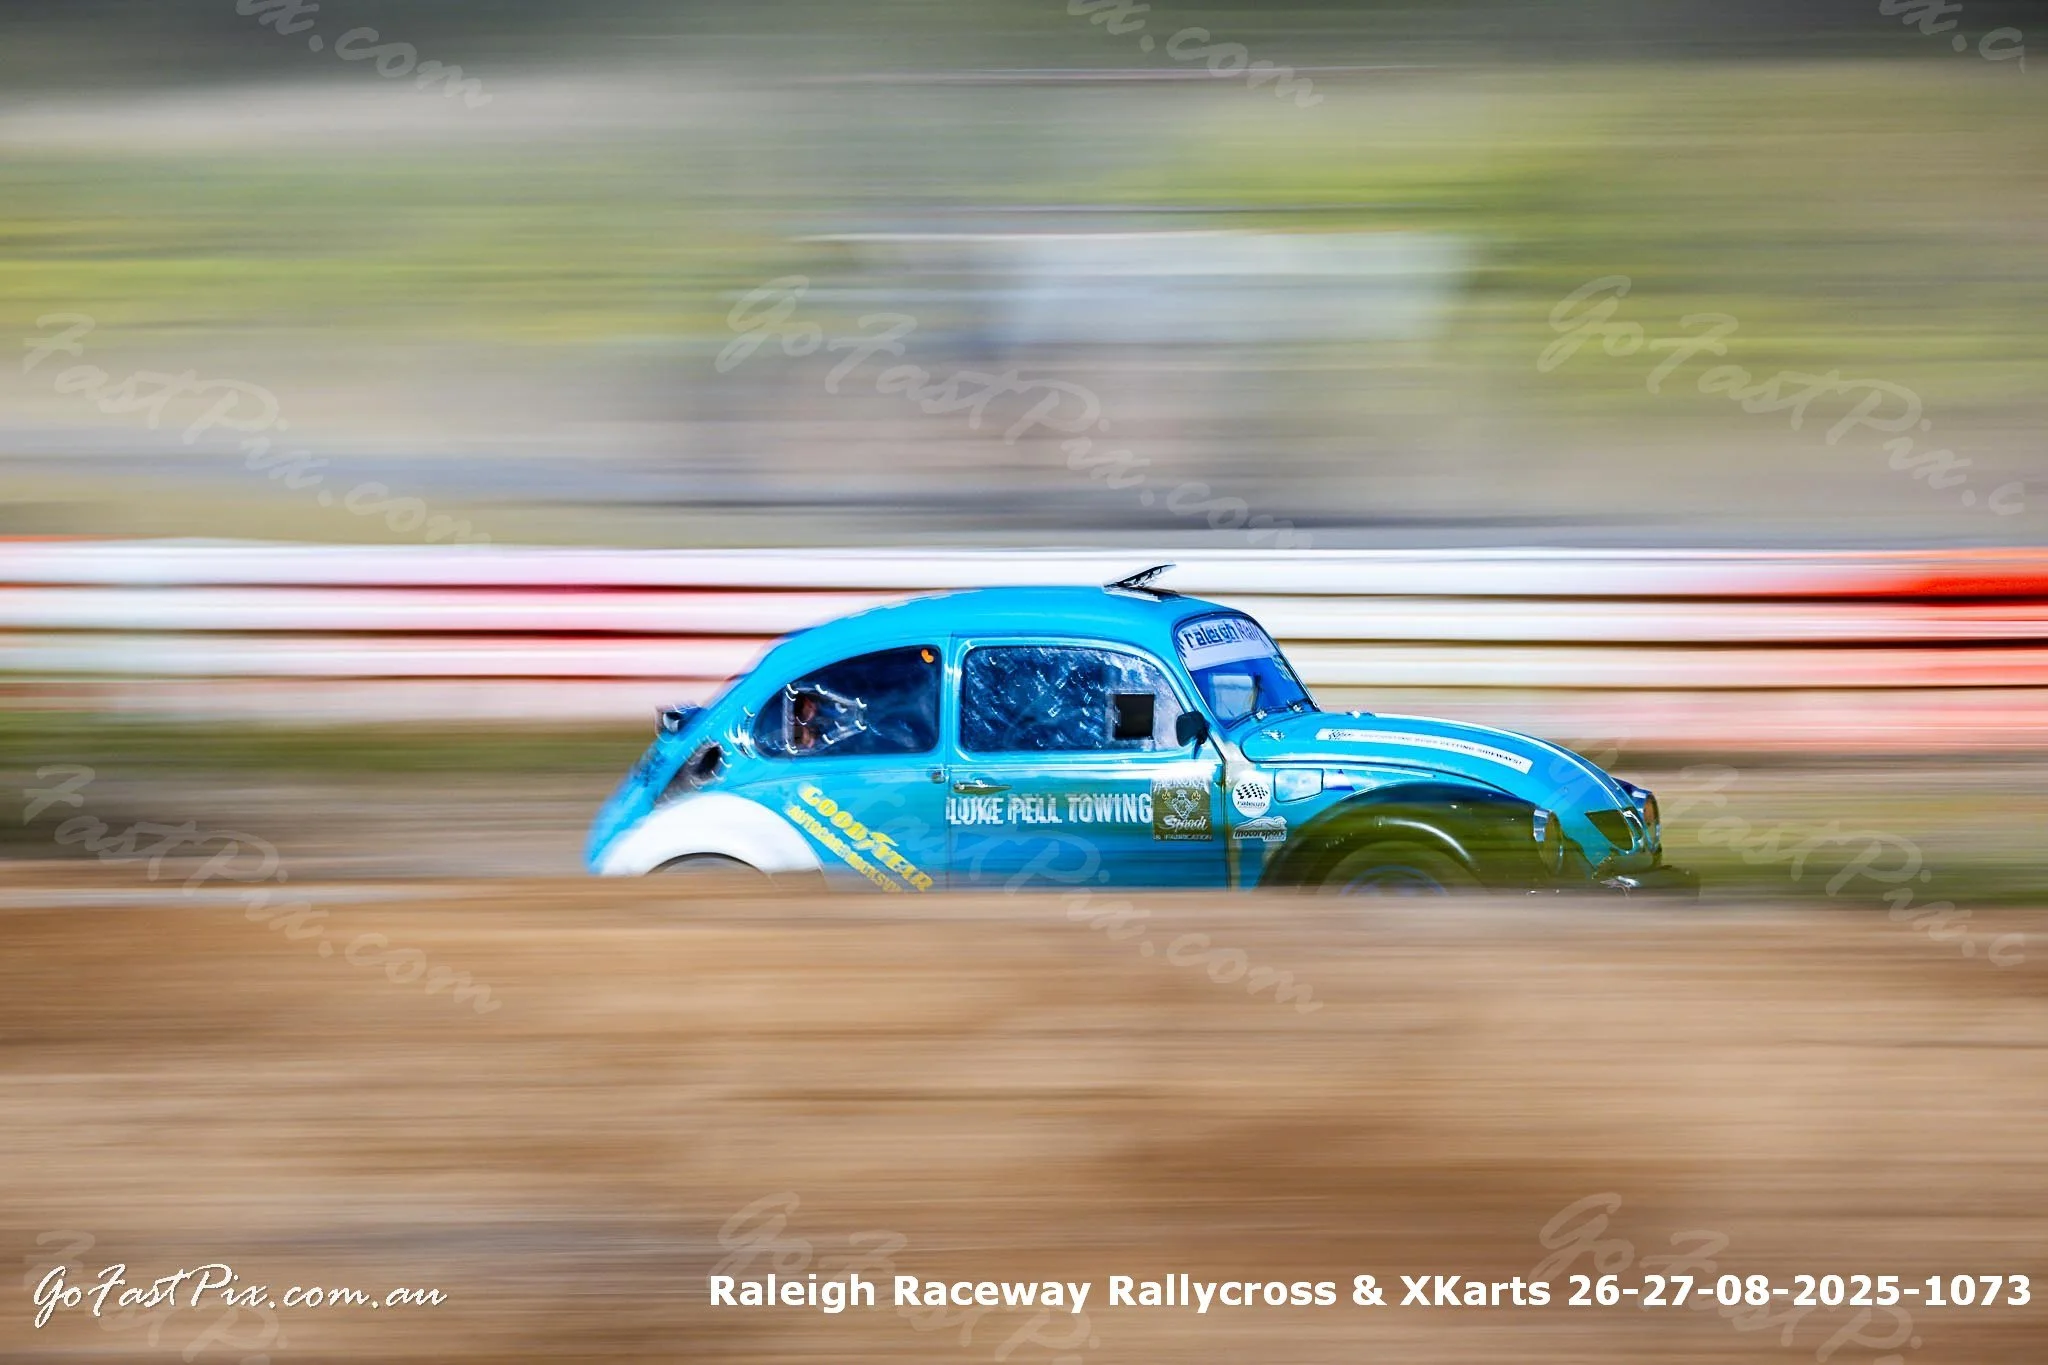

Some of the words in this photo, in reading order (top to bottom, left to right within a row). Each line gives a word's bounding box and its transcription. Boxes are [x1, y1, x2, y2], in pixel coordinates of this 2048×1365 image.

[797, 781, 934, 893] GOODYEAR
[945, 797, 1004, 825] LUKE
[1007, 795, 1062, 824] PELL
[1066, 792, 1152, 824] TOWING
